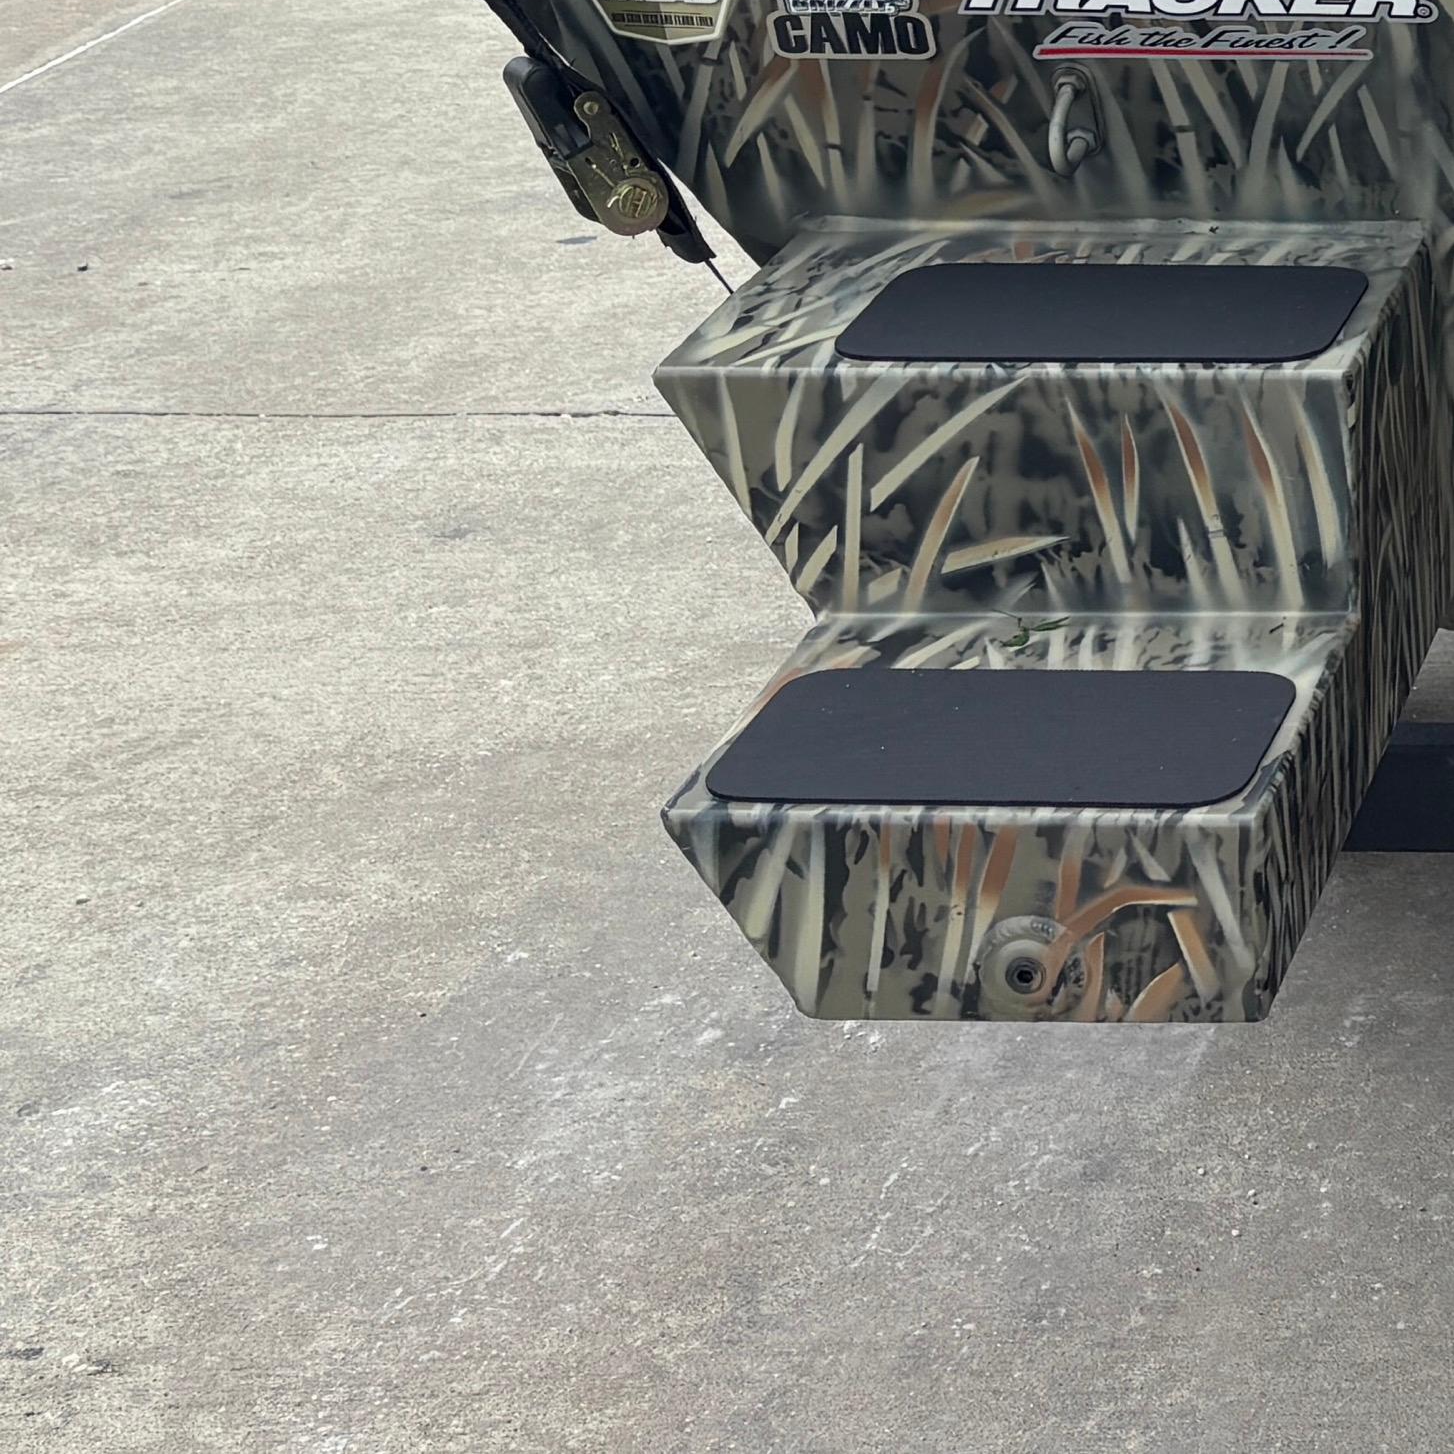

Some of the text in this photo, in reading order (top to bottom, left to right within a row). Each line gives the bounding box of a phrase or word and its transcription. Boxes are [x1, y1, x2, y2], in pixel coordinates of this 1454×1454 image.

[773, 12, 931, 55] CAMO
[1049, 26, 1131, 46] Fish
[1139, 30, 1197, 48] the
